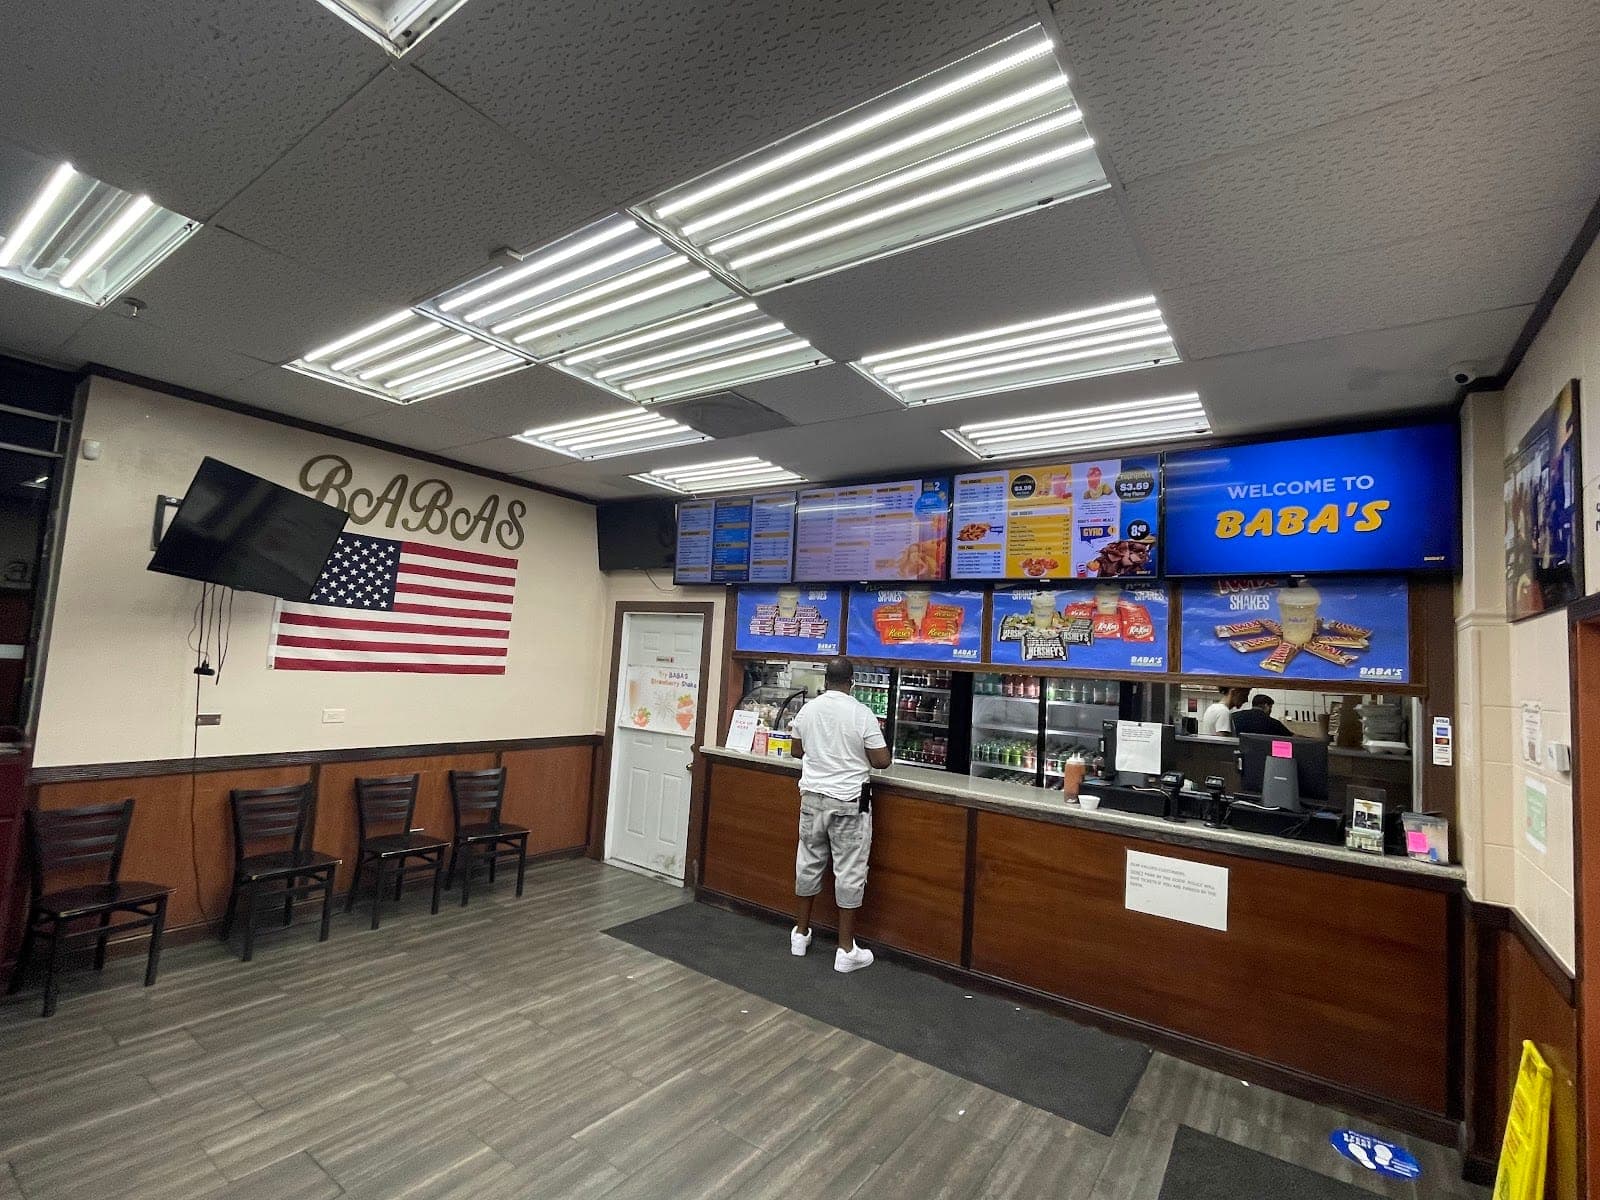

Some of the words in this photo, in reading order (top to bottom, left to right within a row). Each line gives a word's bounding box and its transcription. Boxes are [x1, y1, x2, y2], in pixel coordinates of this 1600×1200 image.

[1227, 478, 1336, 500] WELCOME
[1342, 475, 1375, 491] TO
[299, 454, 527, 551] BABAS
[1214, 500, 1391, 539] BABA'S
[1083, 527, 1103, 537] GYRO
[1230, 594, 1270, 611] SHAKES
[1026, 646, 1065, 660] HERSHEY'S
[1130, 656, 1163, 665] BABA'S
[1360, 667, 1403, 676] BABA'S
[651, 678, 680, 688] Strawberry
[681, 681, 697, 689] Shake
